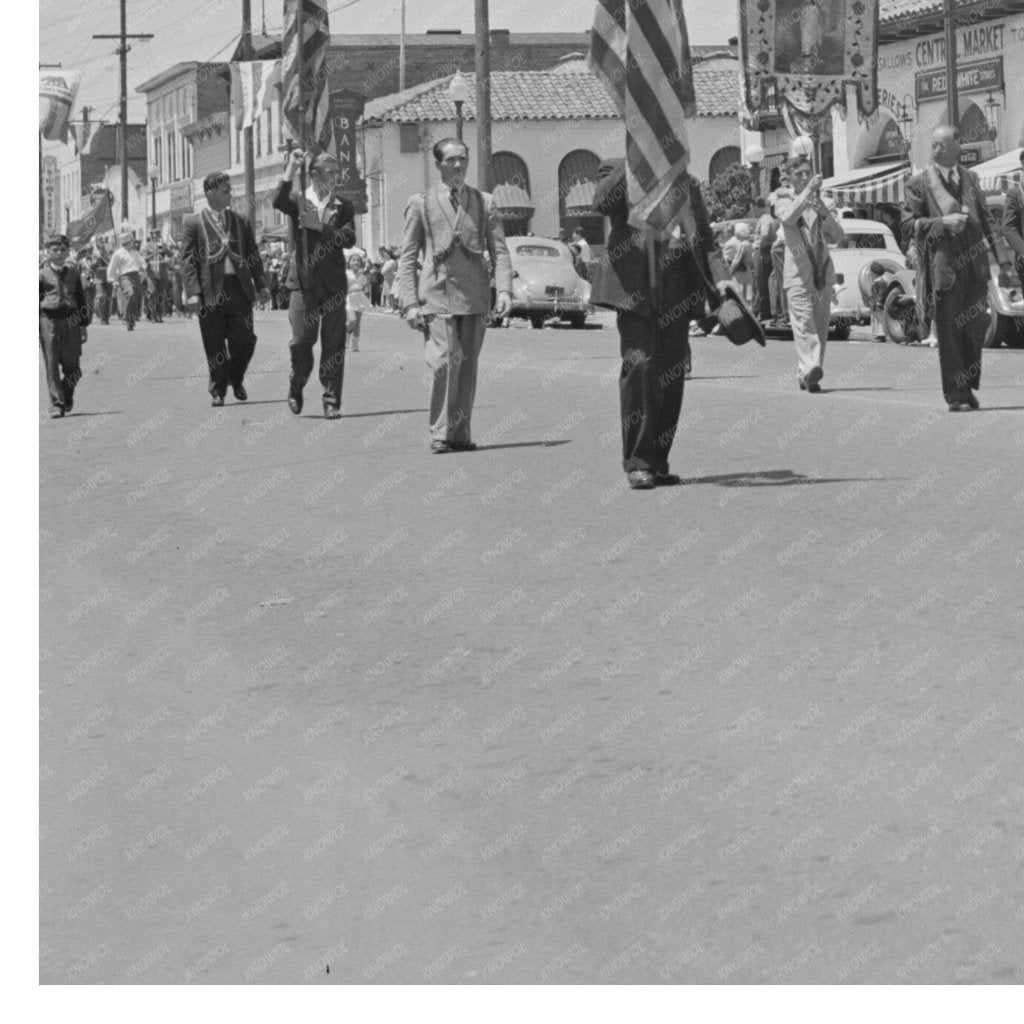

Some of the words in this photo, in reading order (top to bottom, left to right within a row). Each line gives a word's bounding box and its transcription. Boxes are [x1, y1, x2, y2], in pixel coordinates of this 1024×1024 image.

[916, 36, 960, 66] CENTR
[963, 23, 1005, 58] MARKET
[340, 116, 350, 182] BANK
